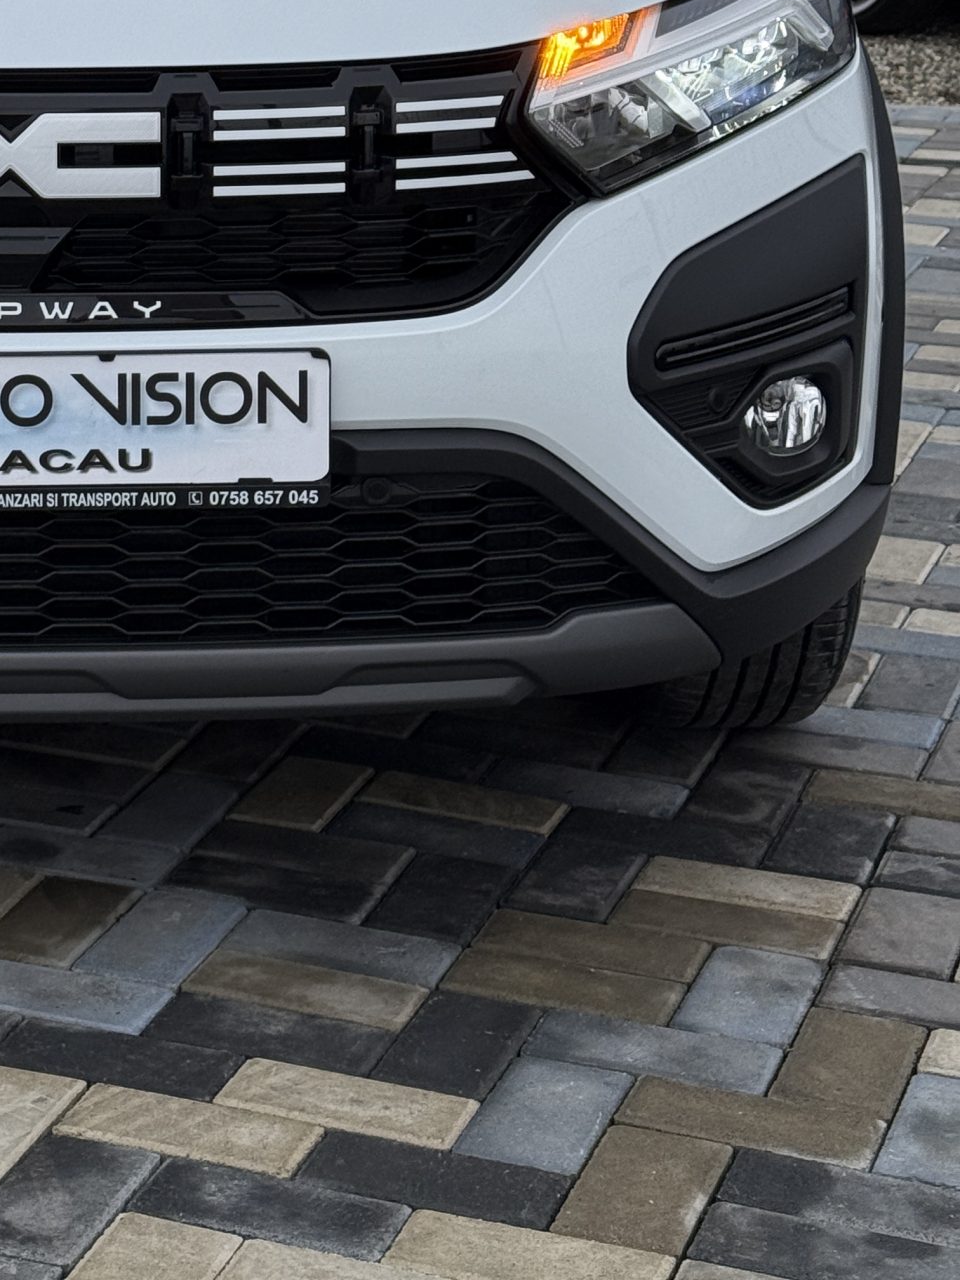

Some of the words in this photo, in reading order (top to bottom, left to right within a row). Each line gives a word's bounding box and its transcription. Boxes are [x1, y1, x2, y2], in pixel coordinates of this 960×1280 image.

[71, 370, 308, 426] VISION
[46, 493, 58, 507] SI
[61, 492, 139, 507] TRANSPORT
[140, 491, 176, 507] AUTO
[209, 490, 249, 506] 0758
[253, 490, 284, 505] 657
[288, 489, 319, 505] 045
